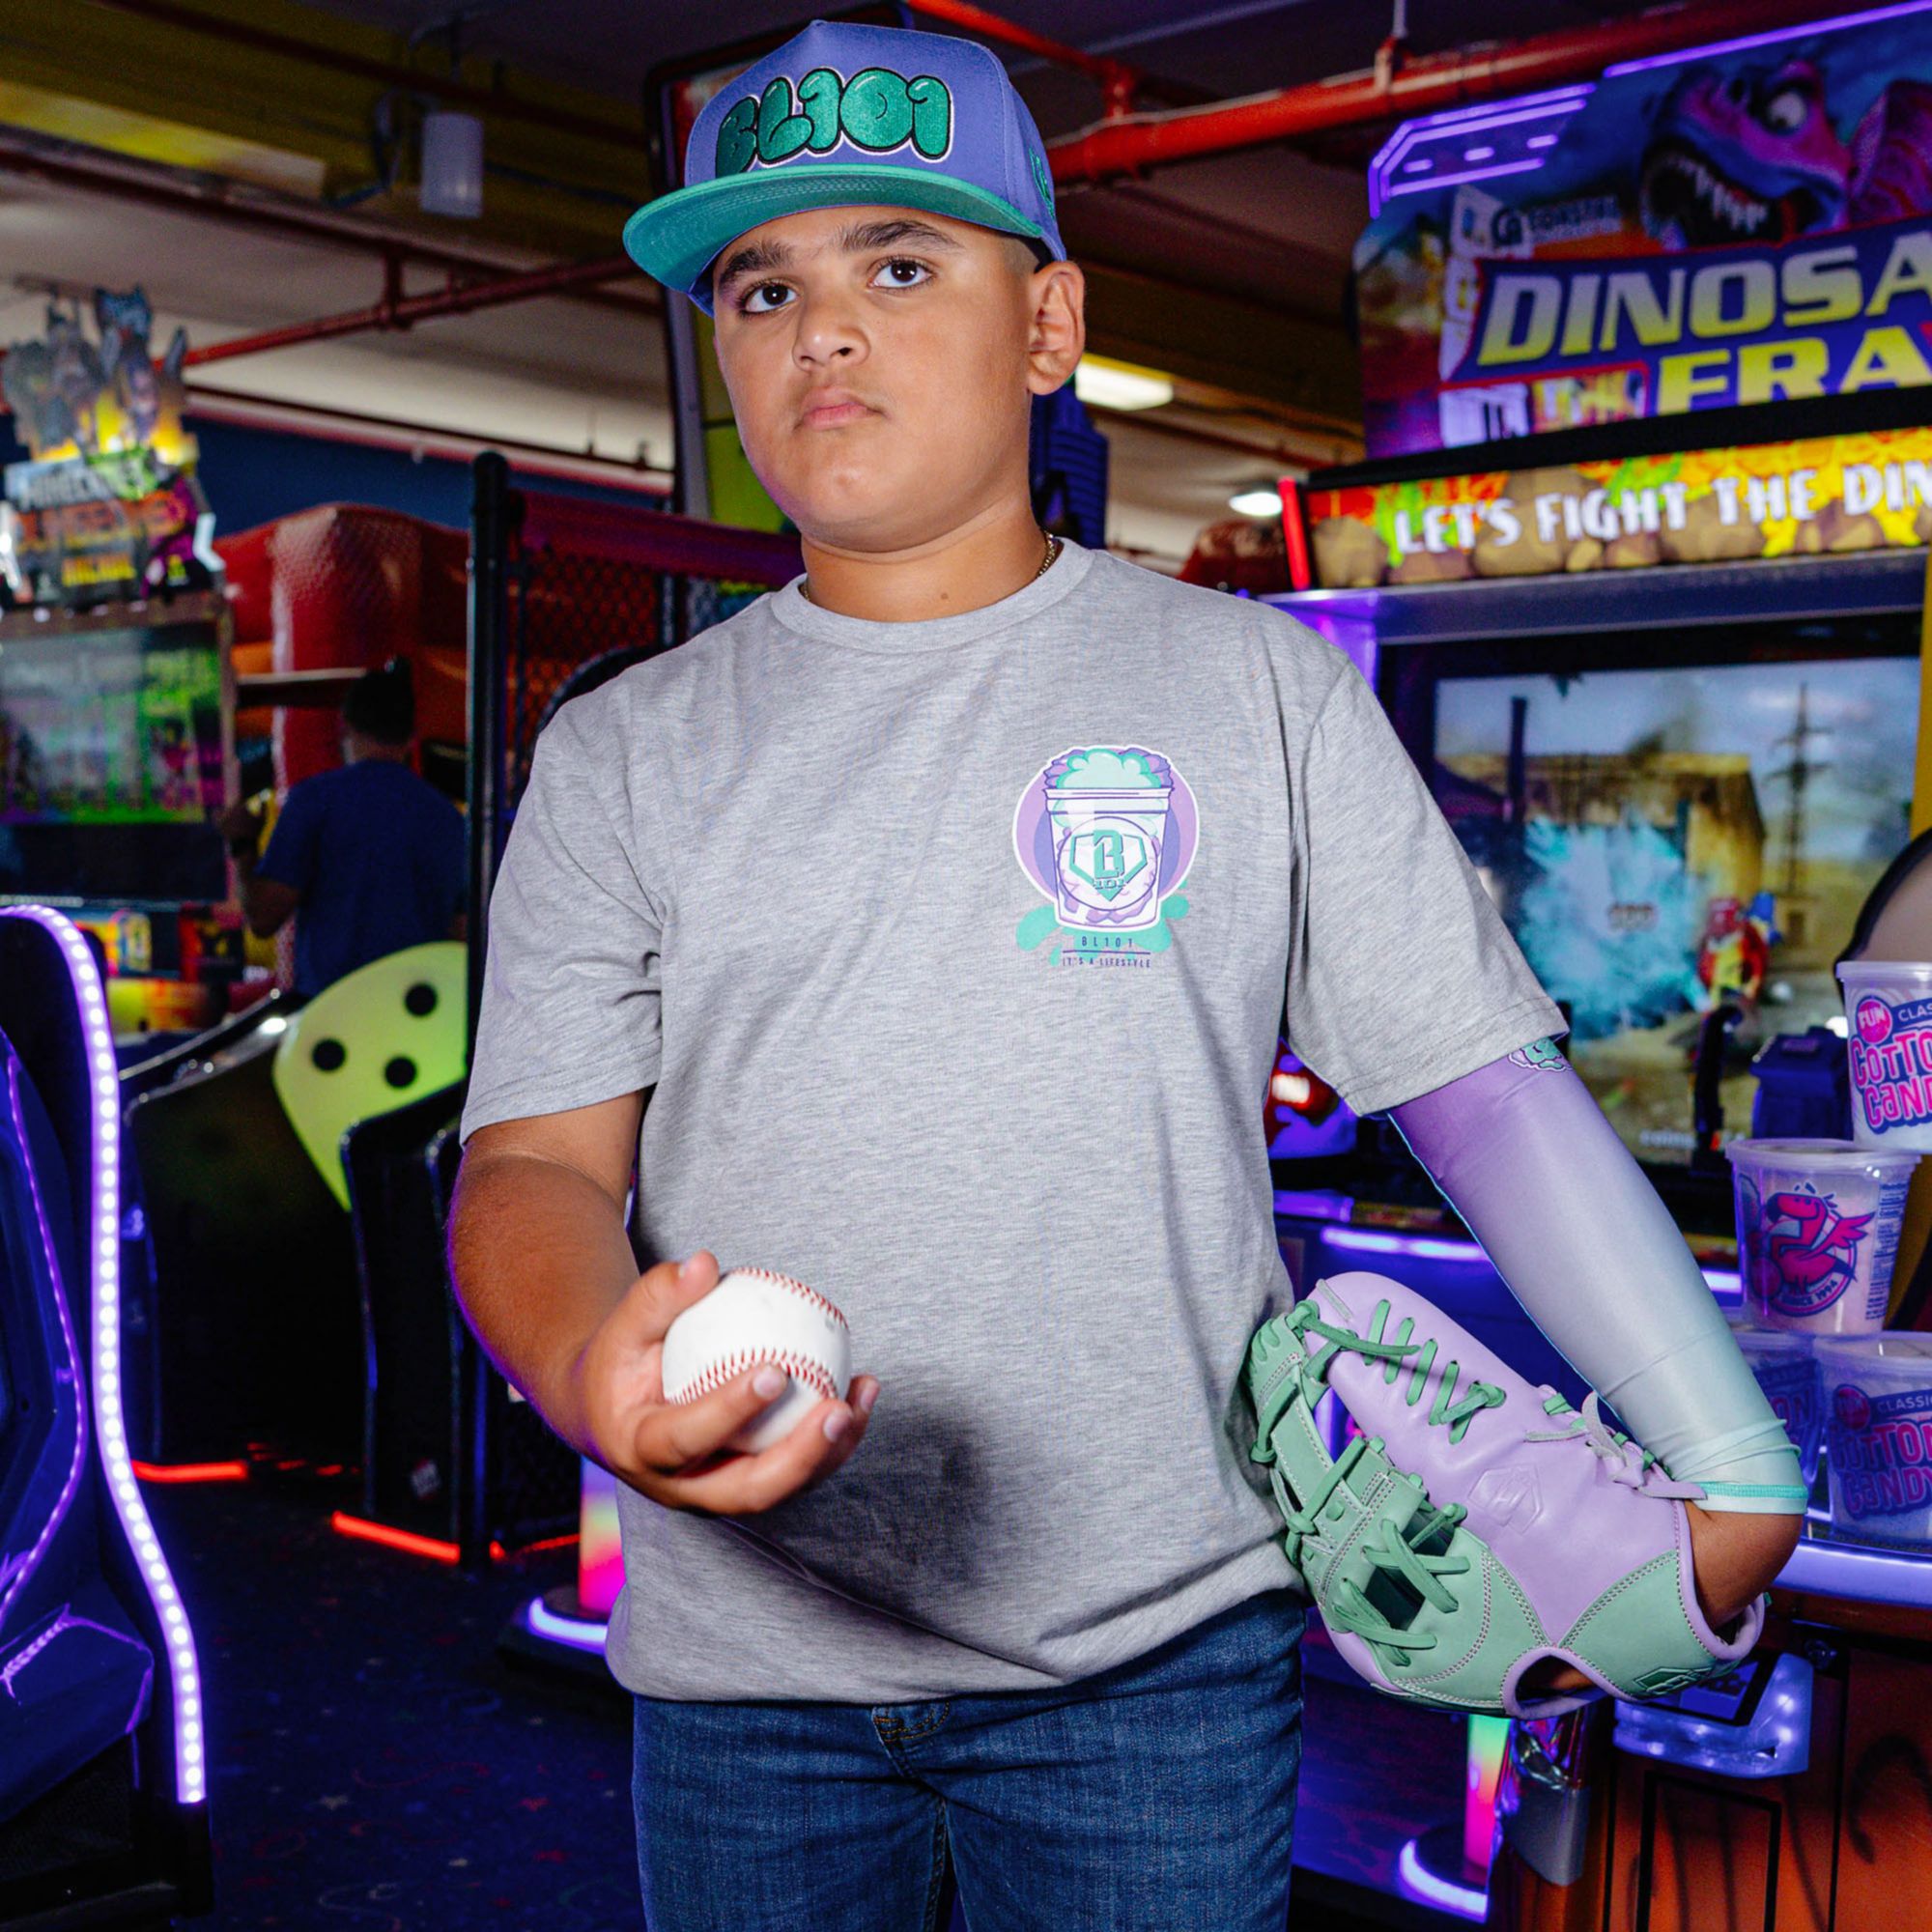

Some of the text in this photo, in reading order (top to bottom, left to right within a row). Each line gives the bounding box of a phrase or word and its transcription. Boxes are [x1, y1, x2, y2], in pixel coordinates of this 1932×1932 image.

[715, 68, 952, 179] BL101
[1477, 231, 1932, 366] DINOSA
[1657, 326, 1932, 415] FRA
[1394, 459, 1932, 554] LET'S FIGHT THE DIN
[1093, 830, 1125, 880] B
[1063, 957, 1084, 966] IT'S
[1099, 957, 1151, 968] LIFESTYLE
[1081, 936, 1132, 948] BL101
[1857, 1006, 1887, 1030] FUN
[1814, 1279, 1837, 1301] 1994
